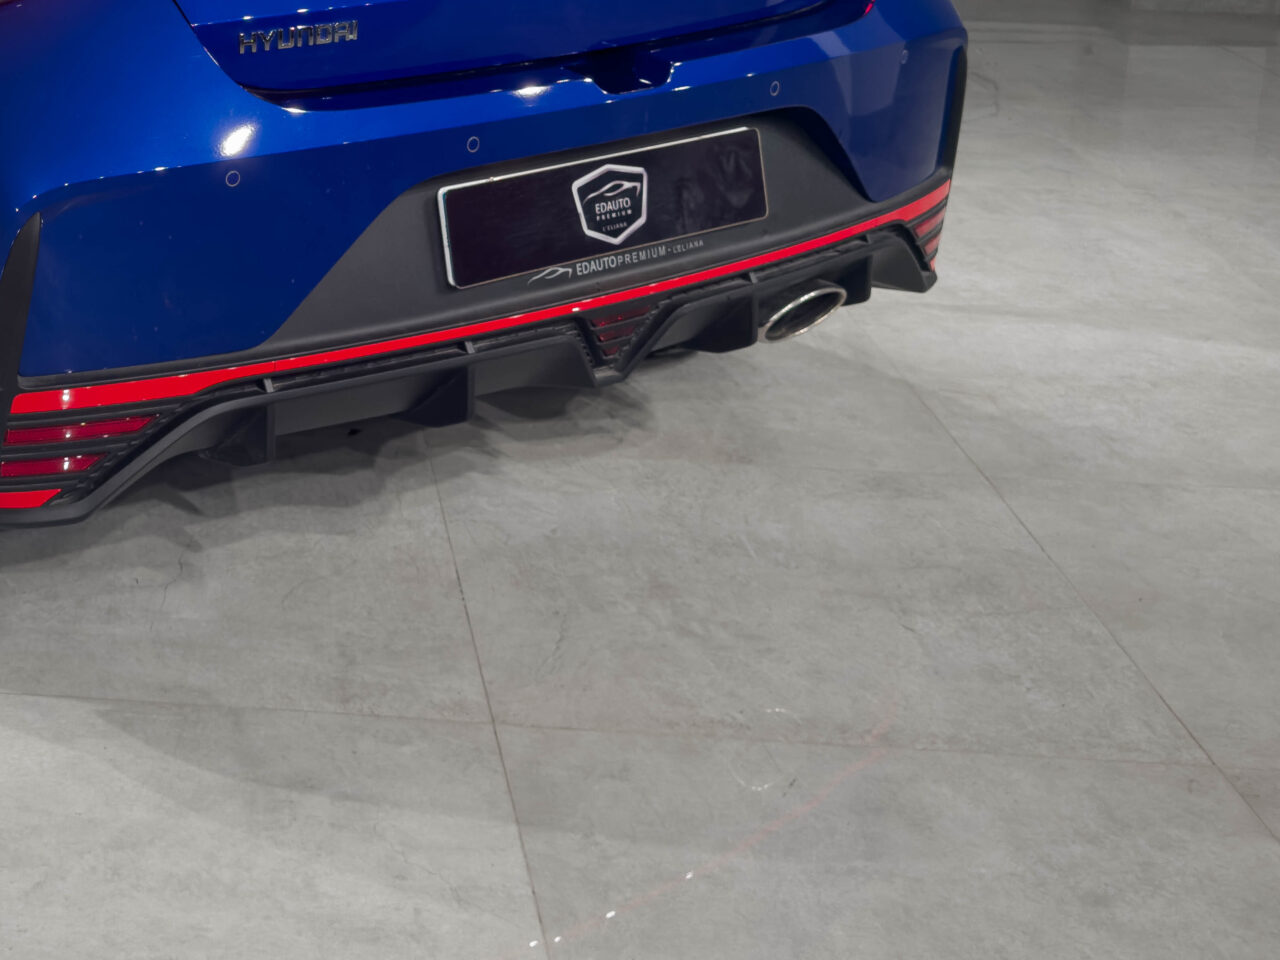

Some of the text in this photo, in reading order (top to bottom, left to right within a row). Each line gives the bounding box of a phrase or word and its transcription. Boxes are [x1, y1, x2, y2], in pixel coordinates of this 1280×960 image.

[239, 20, 358, 54] HYUNDAI
[595, 197, 631, 214] EDAUTO
[596, 209, 632, 221] PREMIUM
